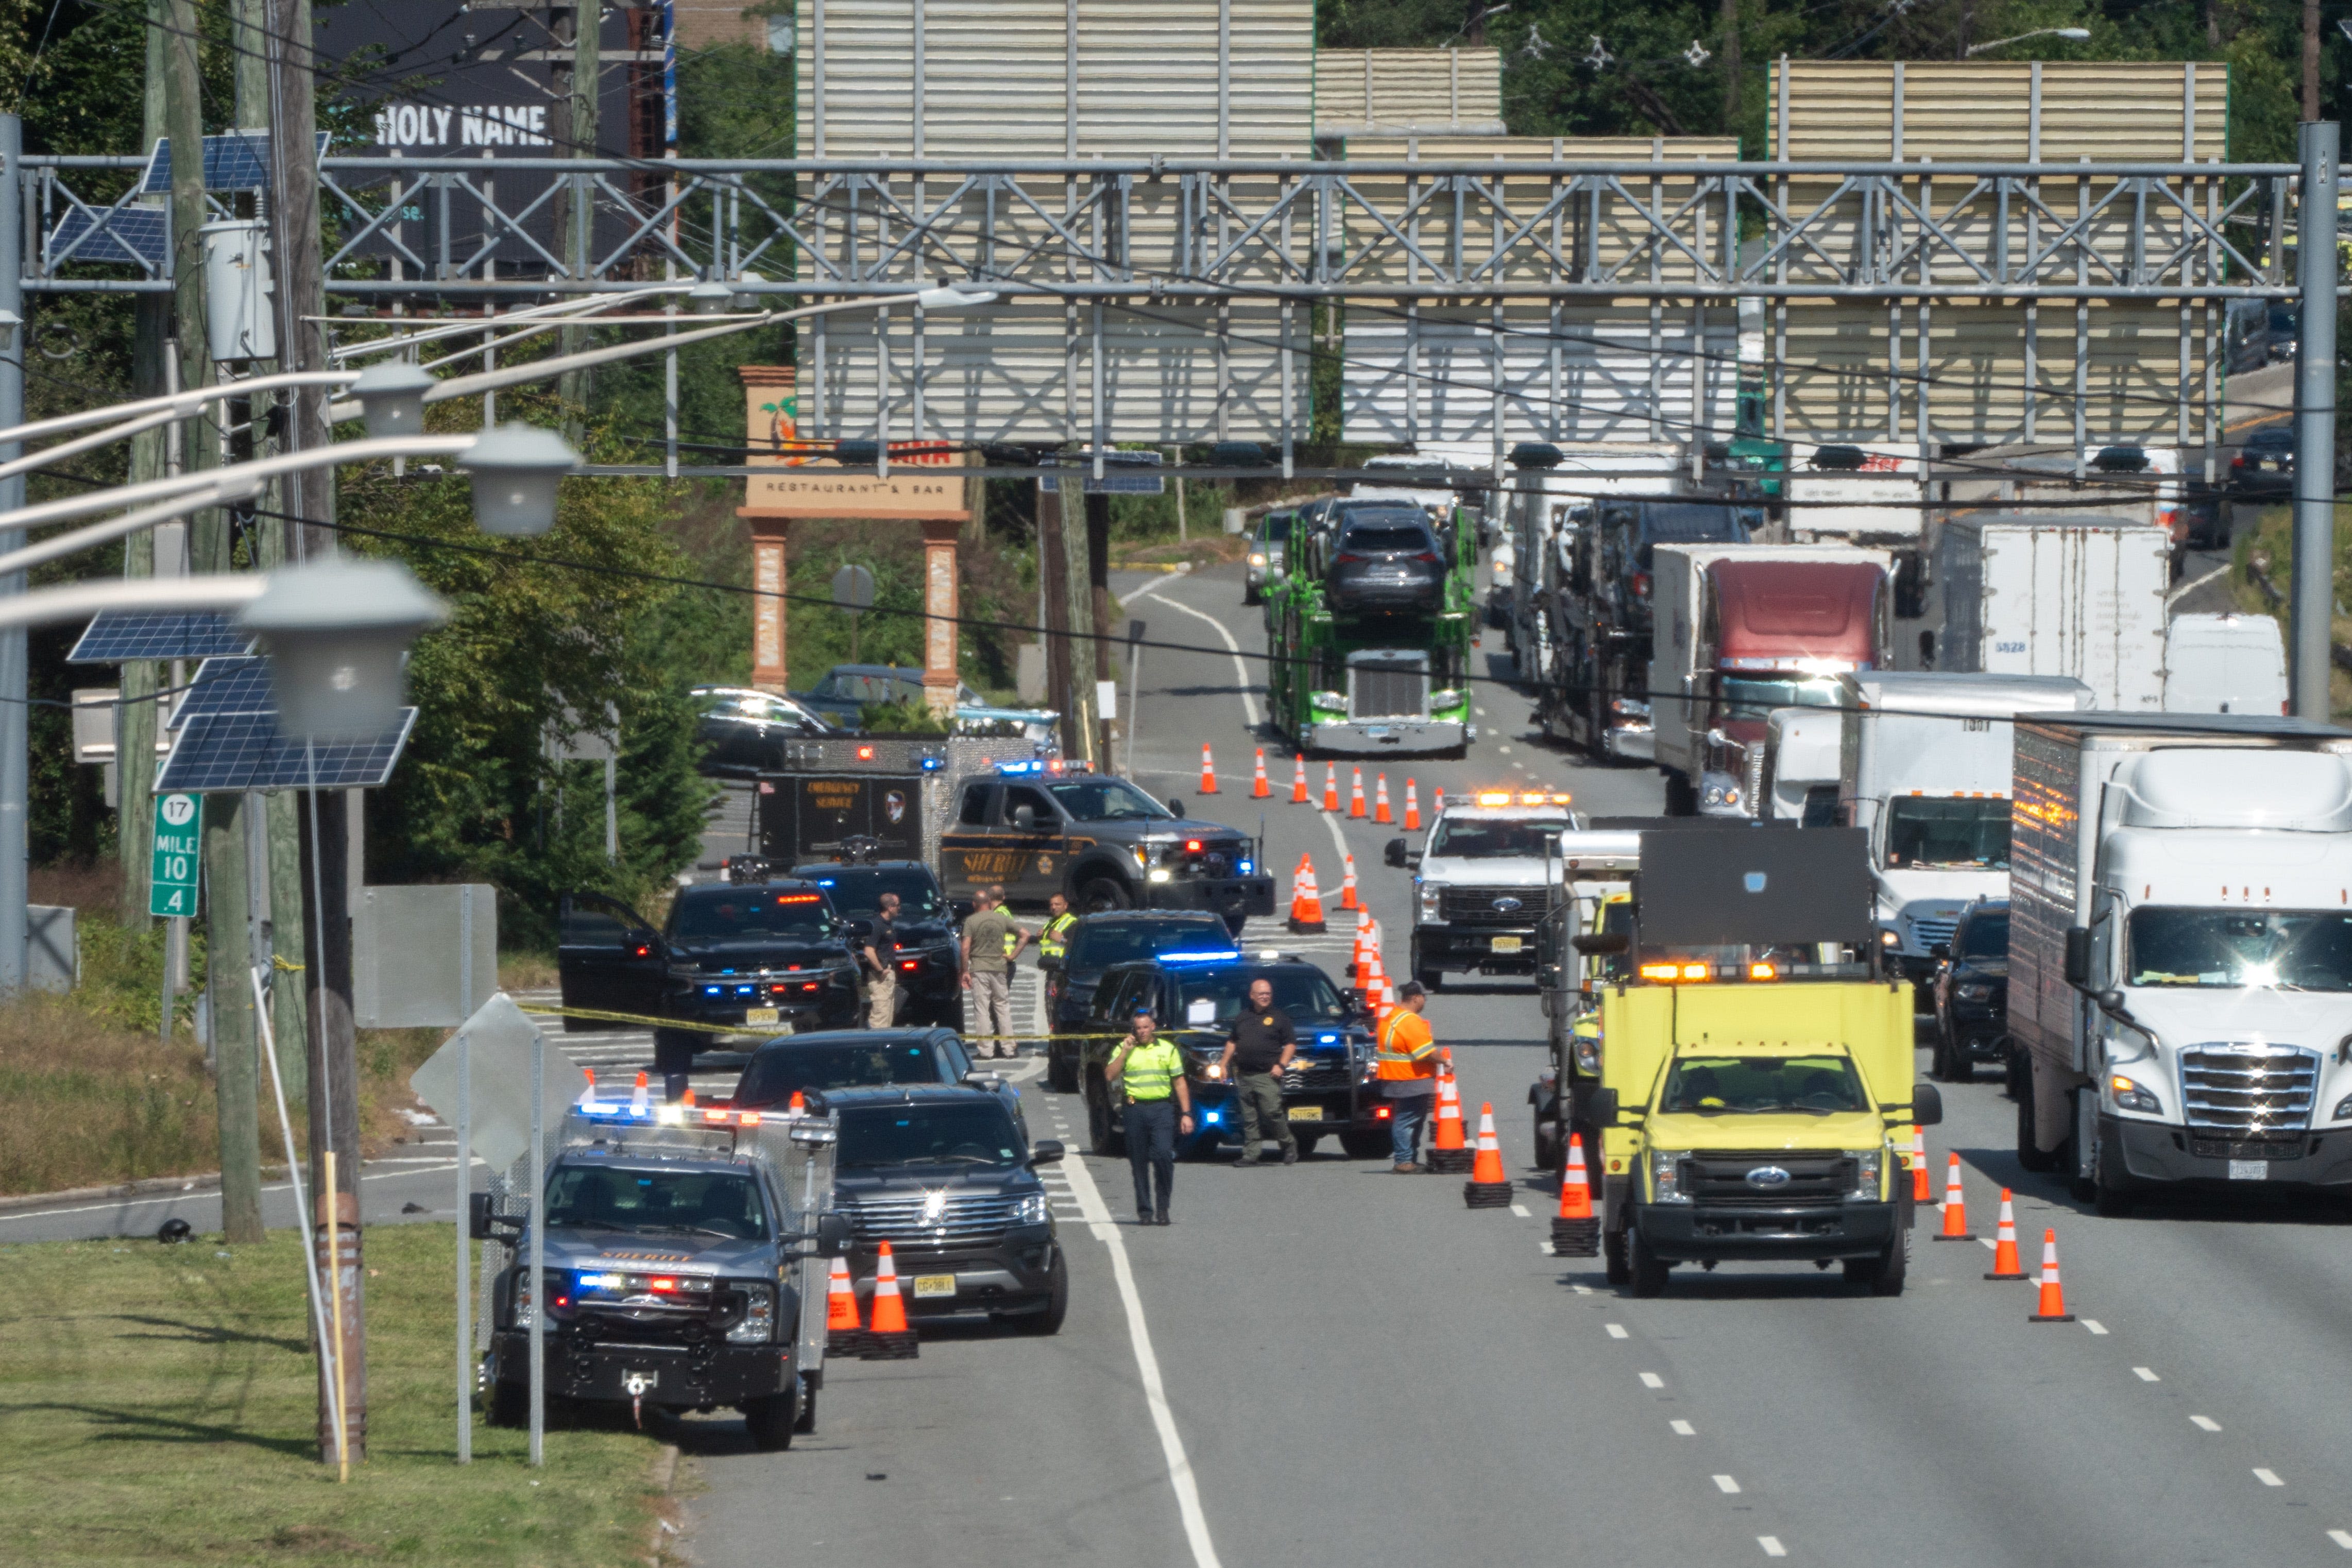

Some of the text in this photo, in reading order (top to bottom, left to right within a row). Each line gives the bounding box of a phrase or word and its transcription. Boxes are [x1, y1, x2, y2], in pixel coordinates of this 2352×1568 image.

[375, 105, 454, 146] HOLY
[766, 482, 944, 495] RESTAURANT & BAR
[168, 801, 188, 817] 17
[156, 834, 196, 855] MILE
[164, 856, 188, 880] 10
[601, 1251, 694, 1262] SHERIFF
